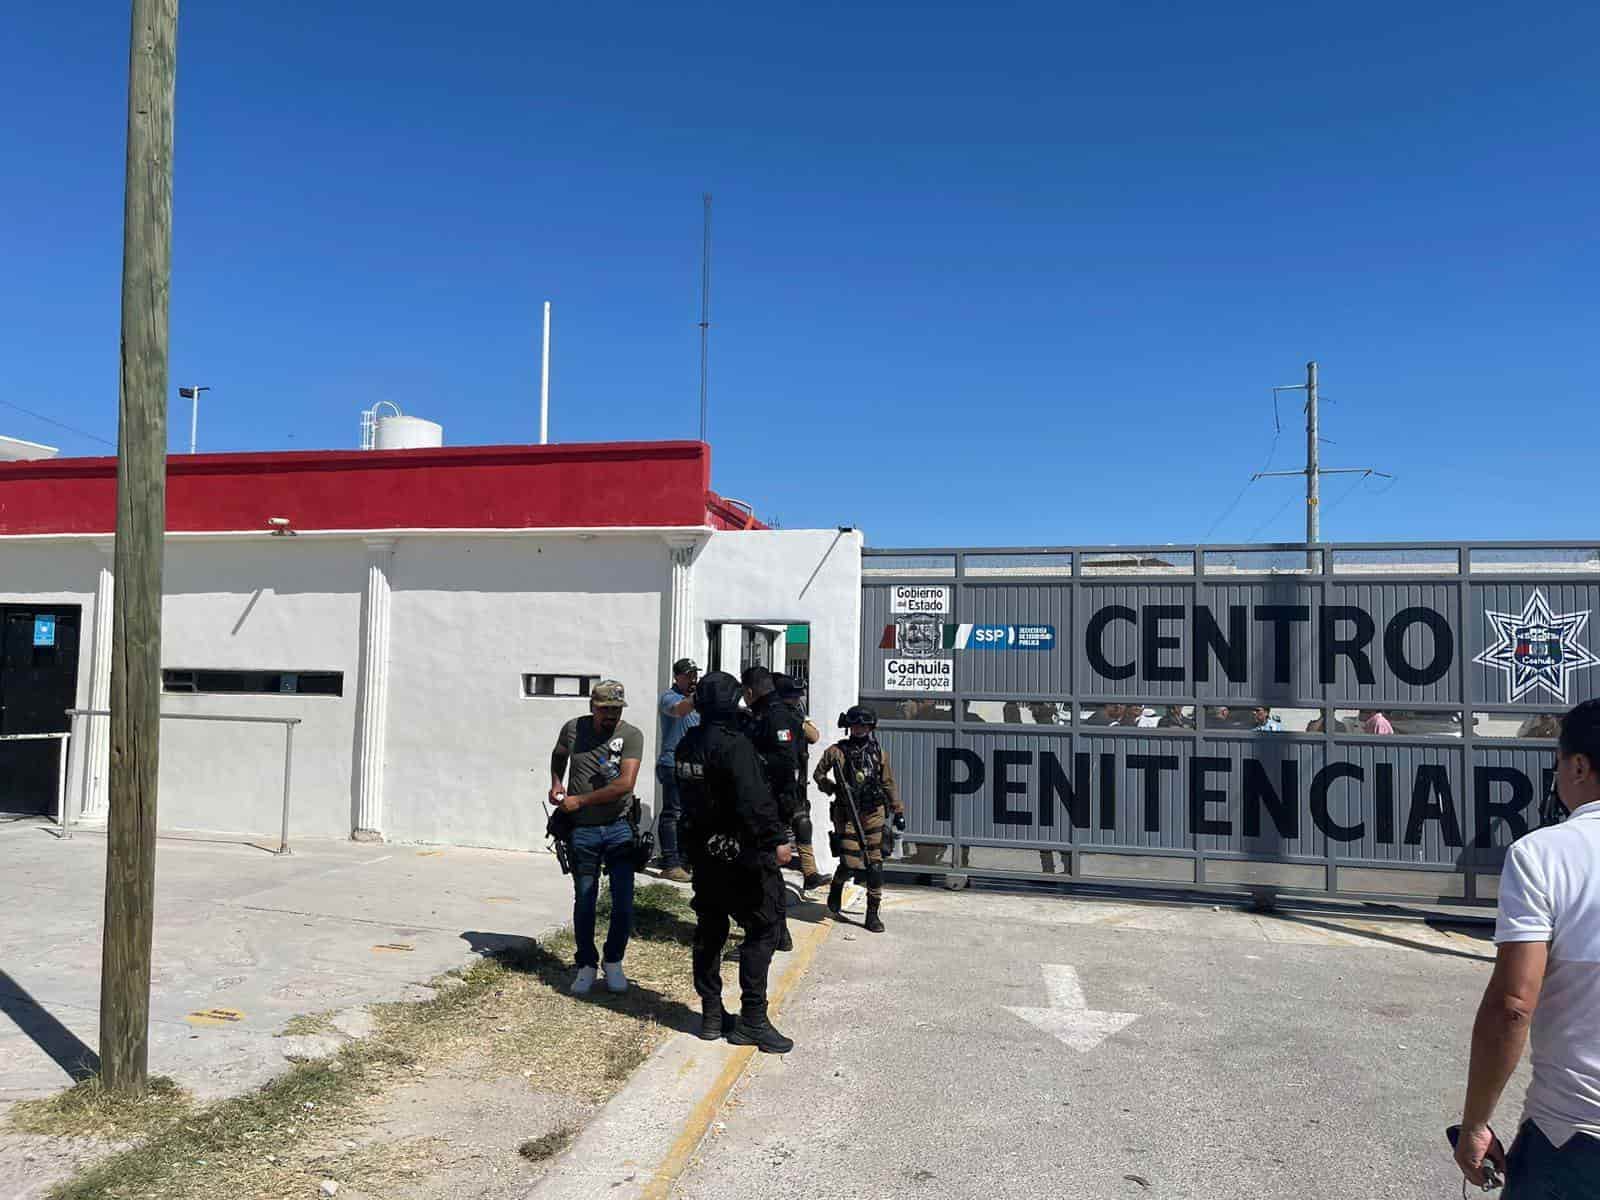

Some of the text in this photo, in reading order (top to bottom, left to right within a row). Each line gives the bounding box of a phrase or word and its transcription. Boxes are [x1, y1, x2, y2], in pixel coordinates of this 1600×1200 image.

[897, 586, 943, 598] Gobierno
[908, 599, 942, 610] Estado
[975, 629, 1004, 642] SSP
[1085, 603, 1454, 686] CENTRO
[888, 660, 950, 674] Coahuila
[898, 675, 950, 690] Zaragoza
